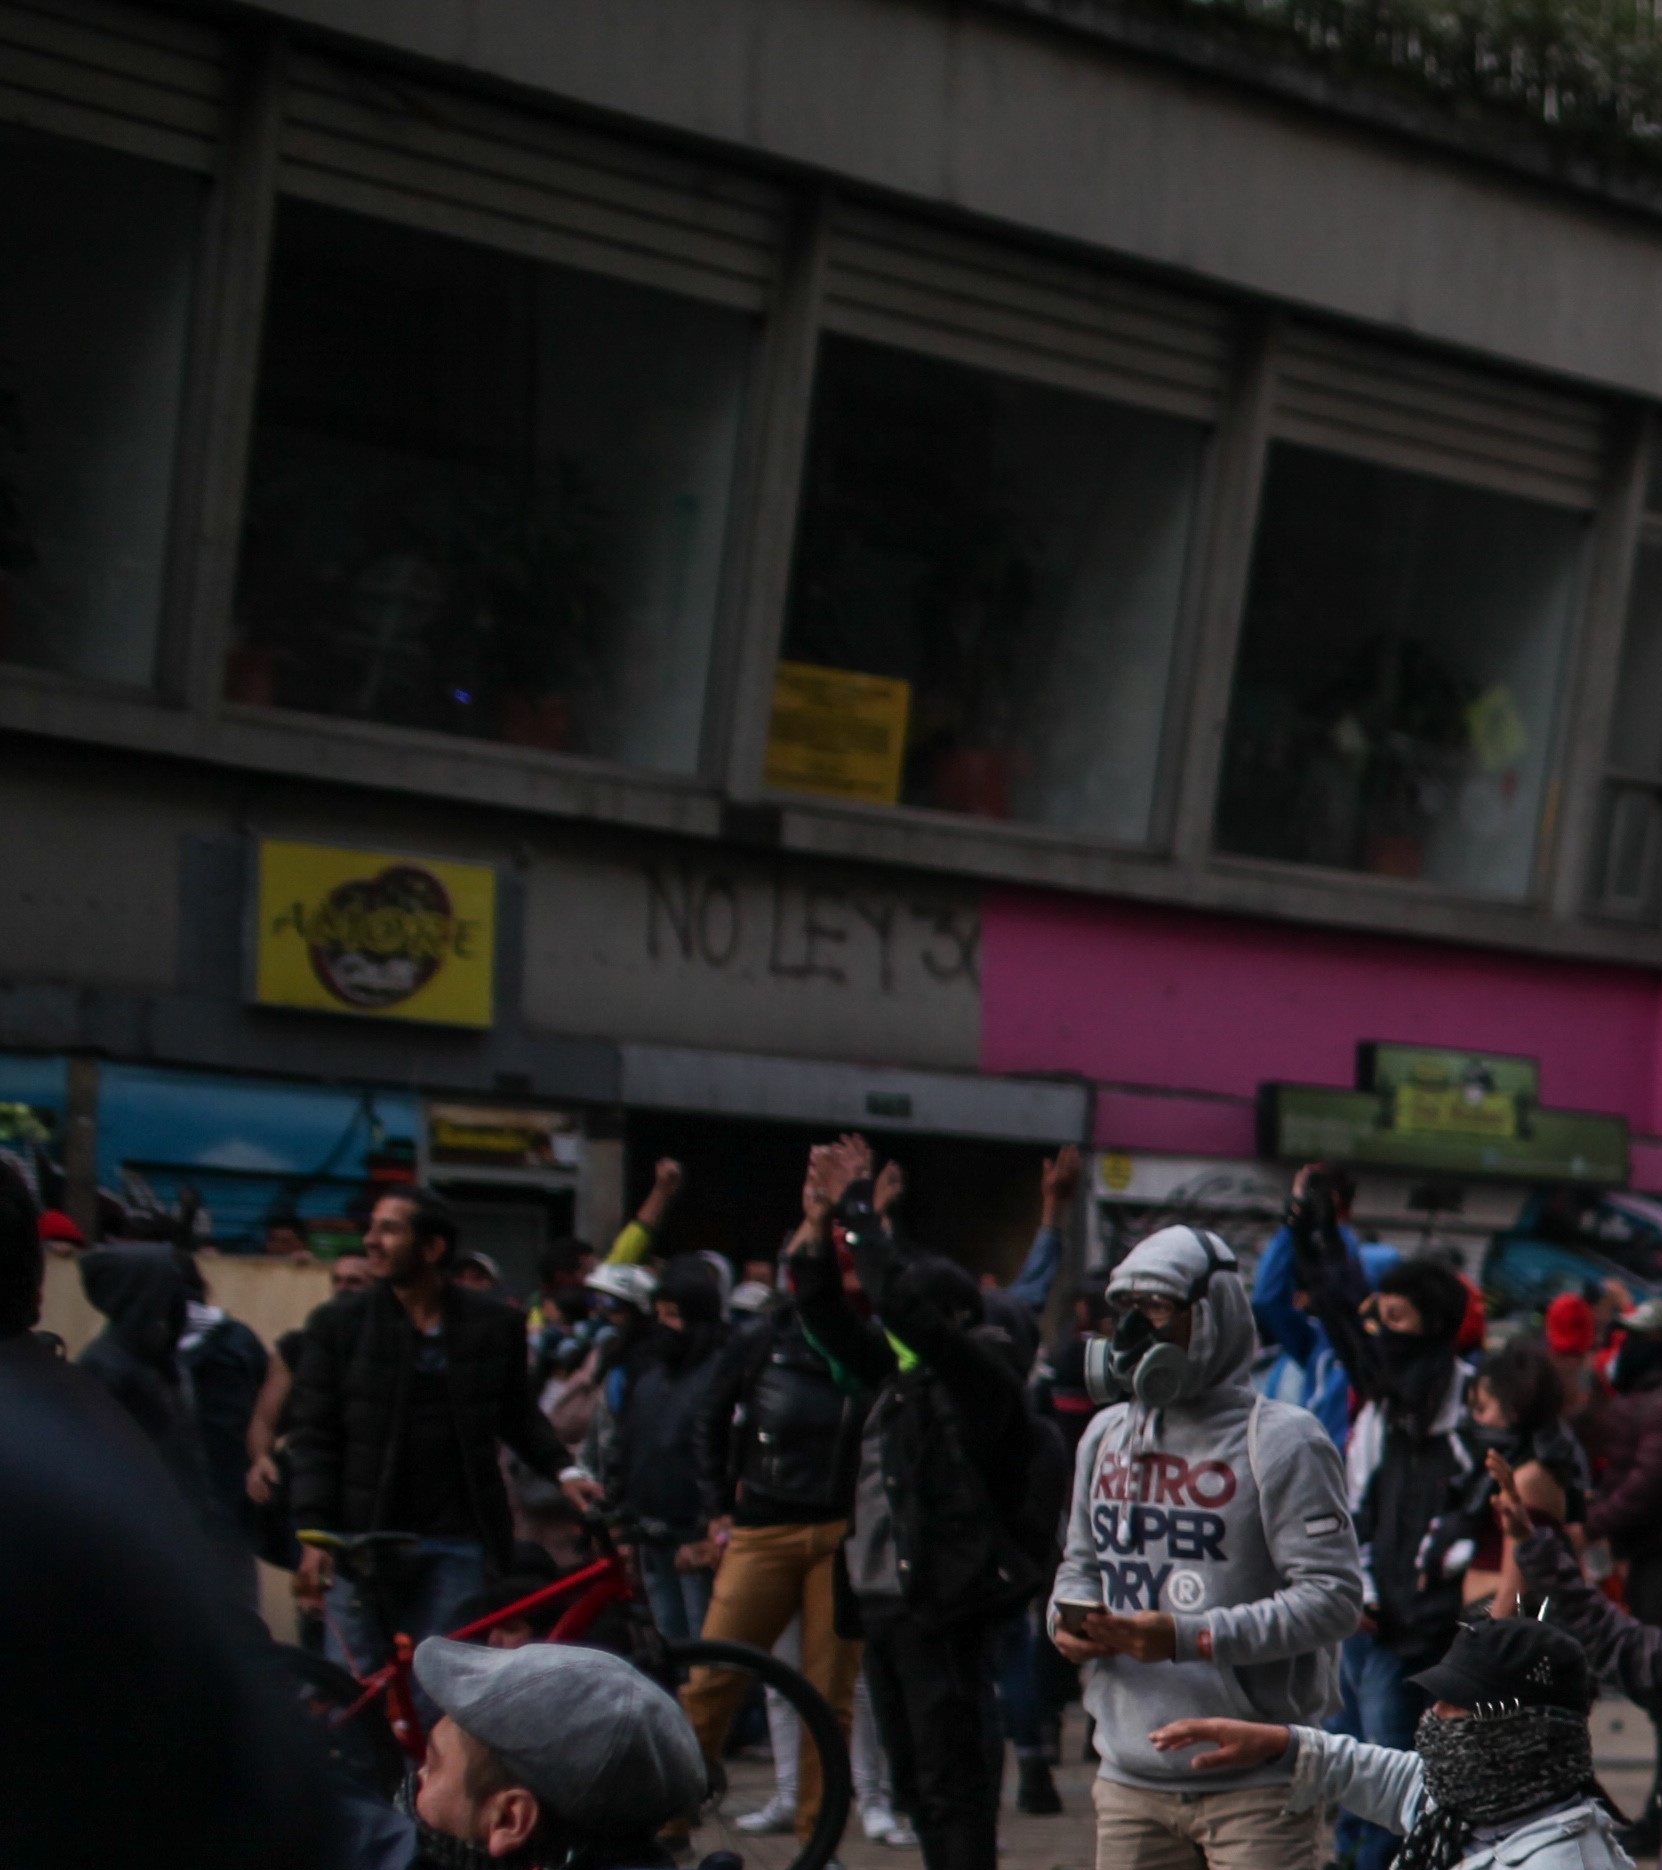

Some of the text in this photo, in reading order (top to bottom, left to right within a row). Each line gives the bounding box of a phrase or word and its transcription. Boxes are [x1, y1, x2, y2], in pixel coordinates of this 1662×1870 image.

[642, 858, 741, 968] NO
[1093, 1453, 1237, 1509] RETRO
[1093, 1504, 1229, 1561] SUPER
